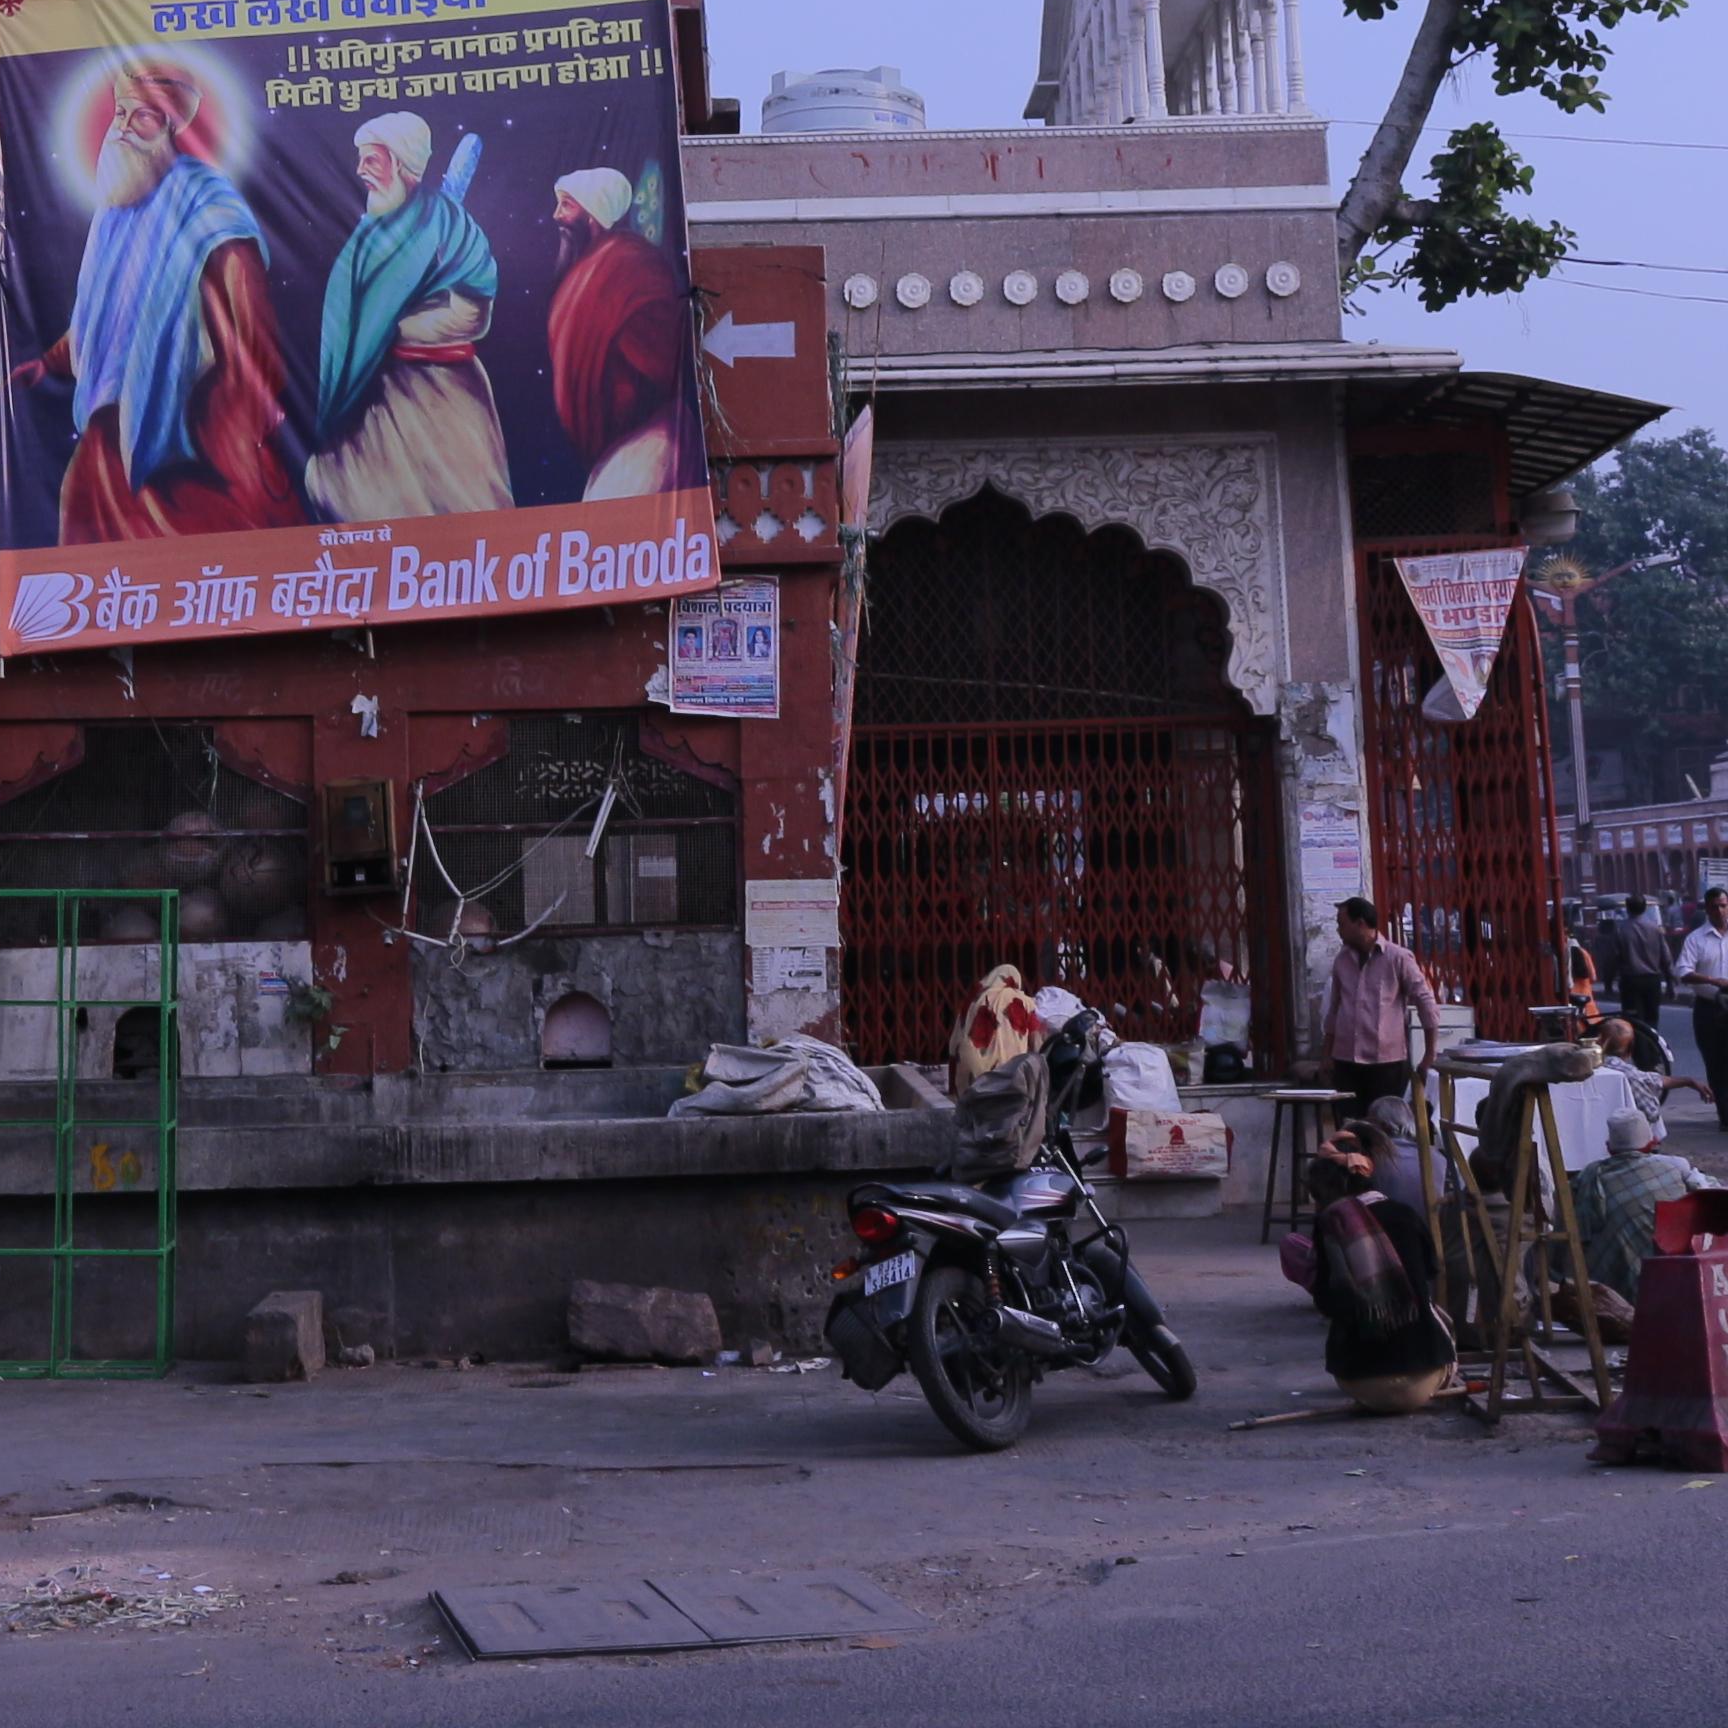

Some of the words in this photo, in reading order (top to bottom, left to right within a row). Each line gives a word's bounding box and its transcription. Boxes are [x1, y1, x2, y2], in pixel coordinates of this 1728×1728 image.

[151, 0, 239, 33] लख
[428, 31, 520, 61] नानक
[522, 17, 643, 54] प्रगटिआ
[265, 76, 334, 109] मिटी
[338, 76, 399, 112] धुन्ध
[403, 71, 458, 98] जग
[461, 63, 552, 93] चानण
[556, 53, 631, 84] होआ
[318, 527, 374, 547] सौजन्य
[376, 523, 393, 542] से
[387, 538, 501, 611] Bank
[507, 532, 551, 600] of
[557, 518, 711, 596] Baroda
[95, 565, 161, 632] बैंक
[271, 550, 379, 627] बड़ौदा
[677, 599, 719, 614] विशाल
[723, 601, 772, 613] पदयात्रा
